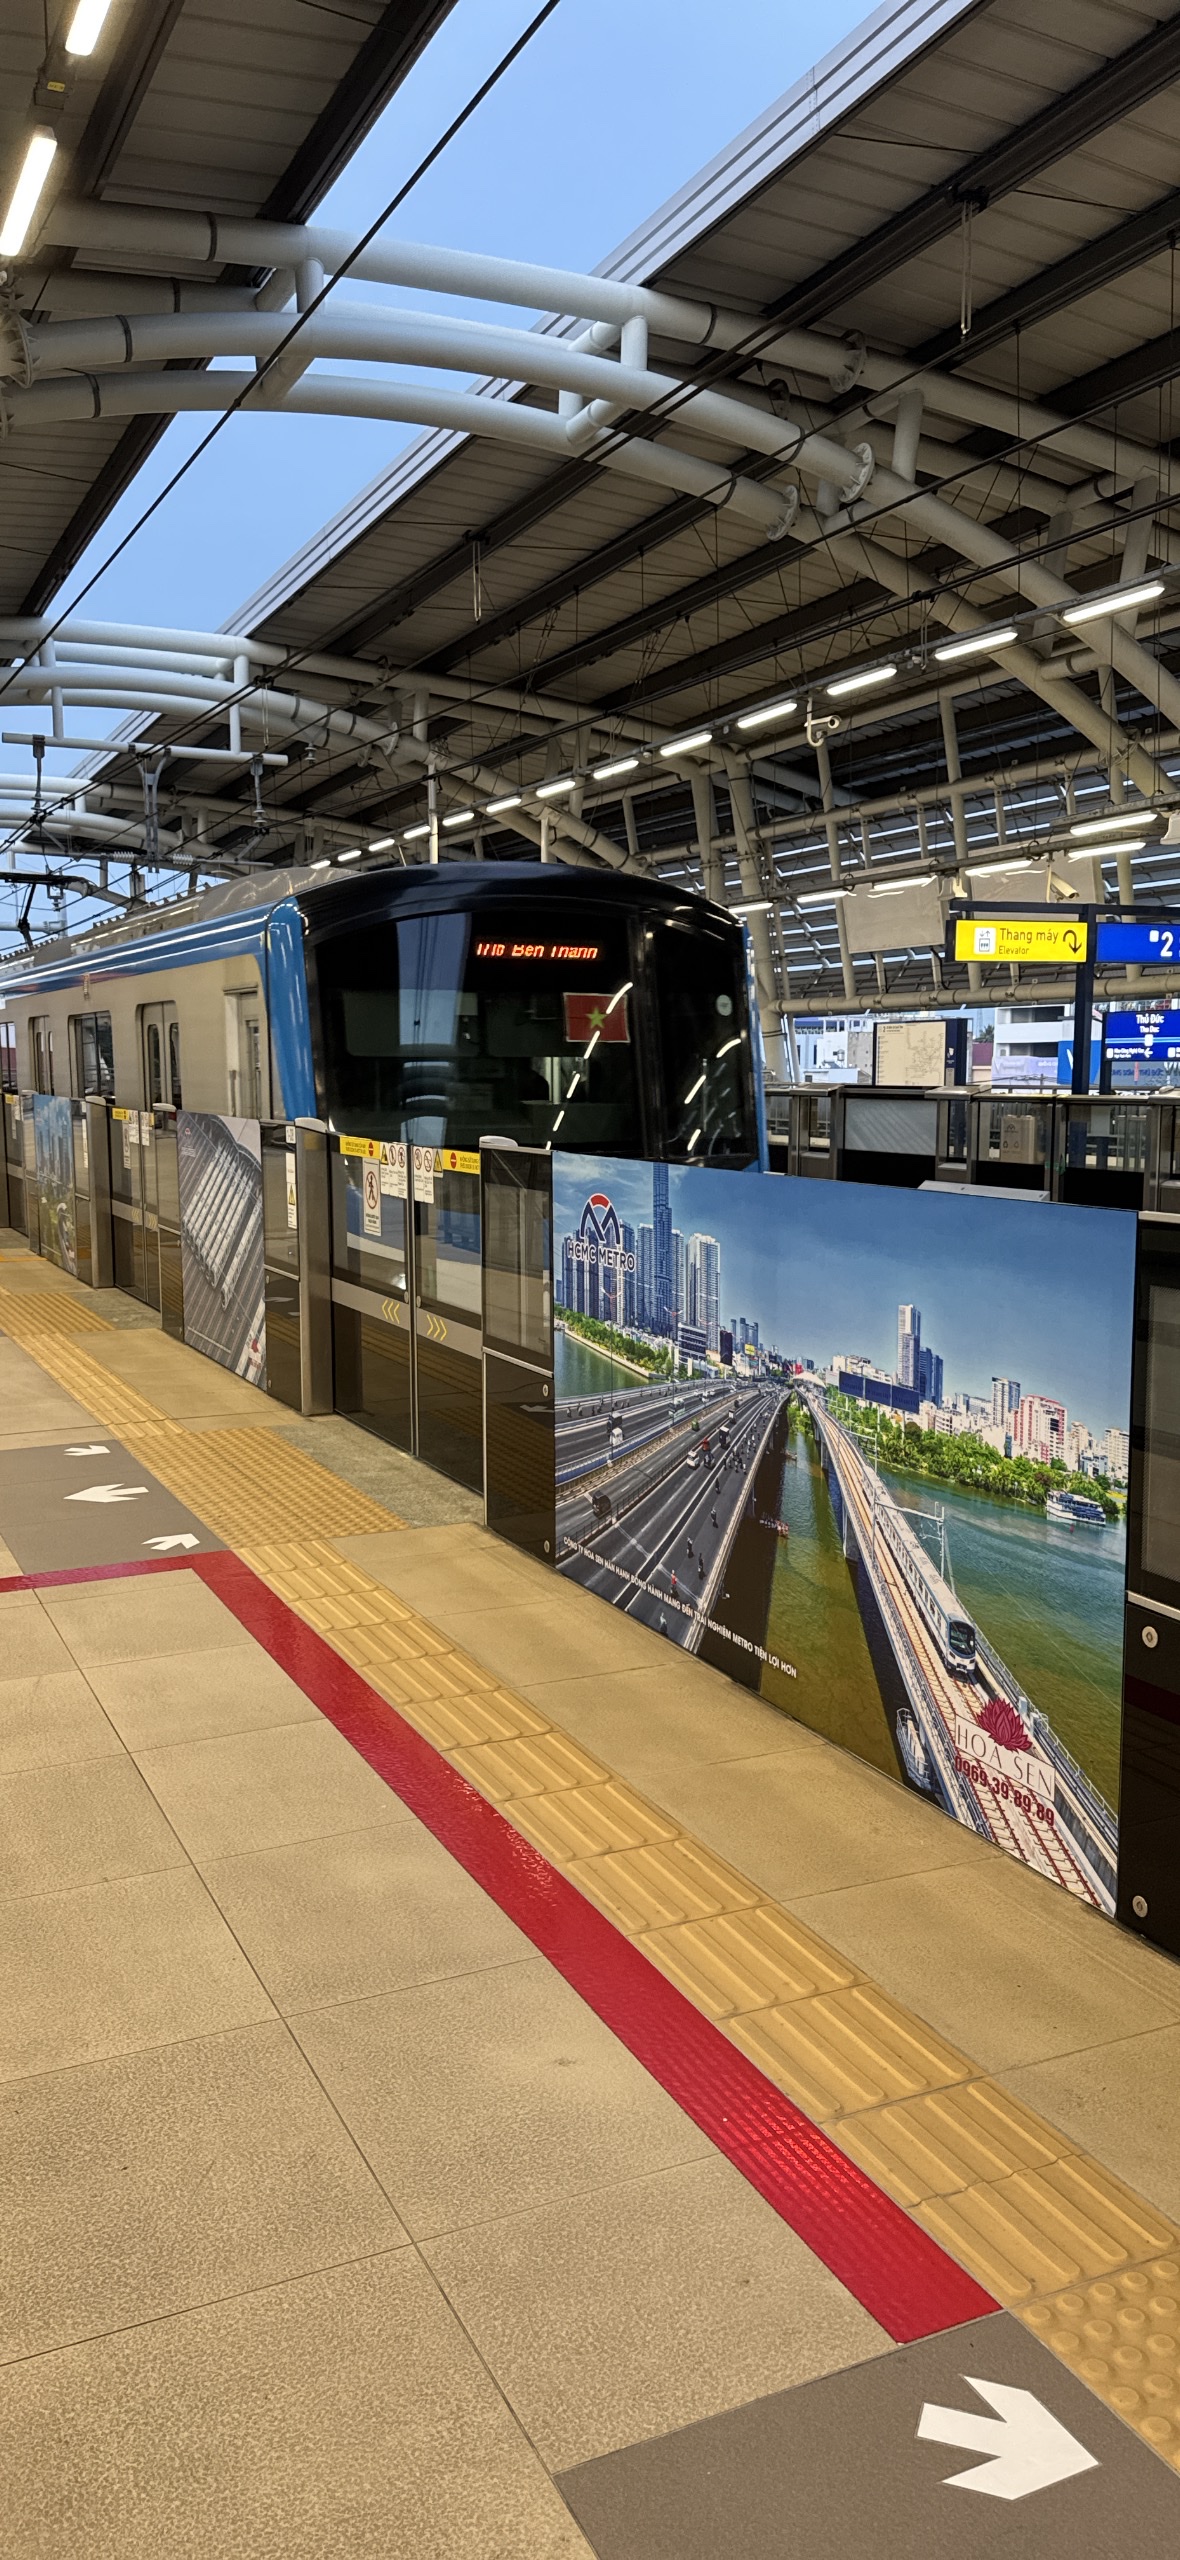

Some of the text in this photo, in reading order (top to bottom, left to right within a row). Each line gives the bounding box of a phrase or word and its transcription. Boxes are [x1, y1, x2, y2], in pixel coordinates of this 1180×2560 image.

[1000, 927, 1059, 944] Thang máy
[1160, 931, 1174, 957] 2
[998, 945, 1030, 955] Elevator
[1136, 1013, 1165, 1024] Thủ Đức
[567, 1240, 636, 1272] HCMC METRO
[563, 1536, 578, 1550] CÔNG
[584, 1548, 595, 1560] HOA
[595, 1554, 604, 1566] SEN
[647, 1583, 663, 1600] HÀNH
[663, 1592, 681, 1610] MANG
[681, 1601, 693, 1617] ĐẾN
[707, 1620, 732, 1639] NGHIỆM
[732, 1632, 753, 1653] METRO
[754, 1645, 767, 1661] TIỆN
[768, 1653, 780, 1669] LỢI
[780, 1660, 797, 1678] HƠN
[957, 1724, 1053, 1797] HOA SEN
